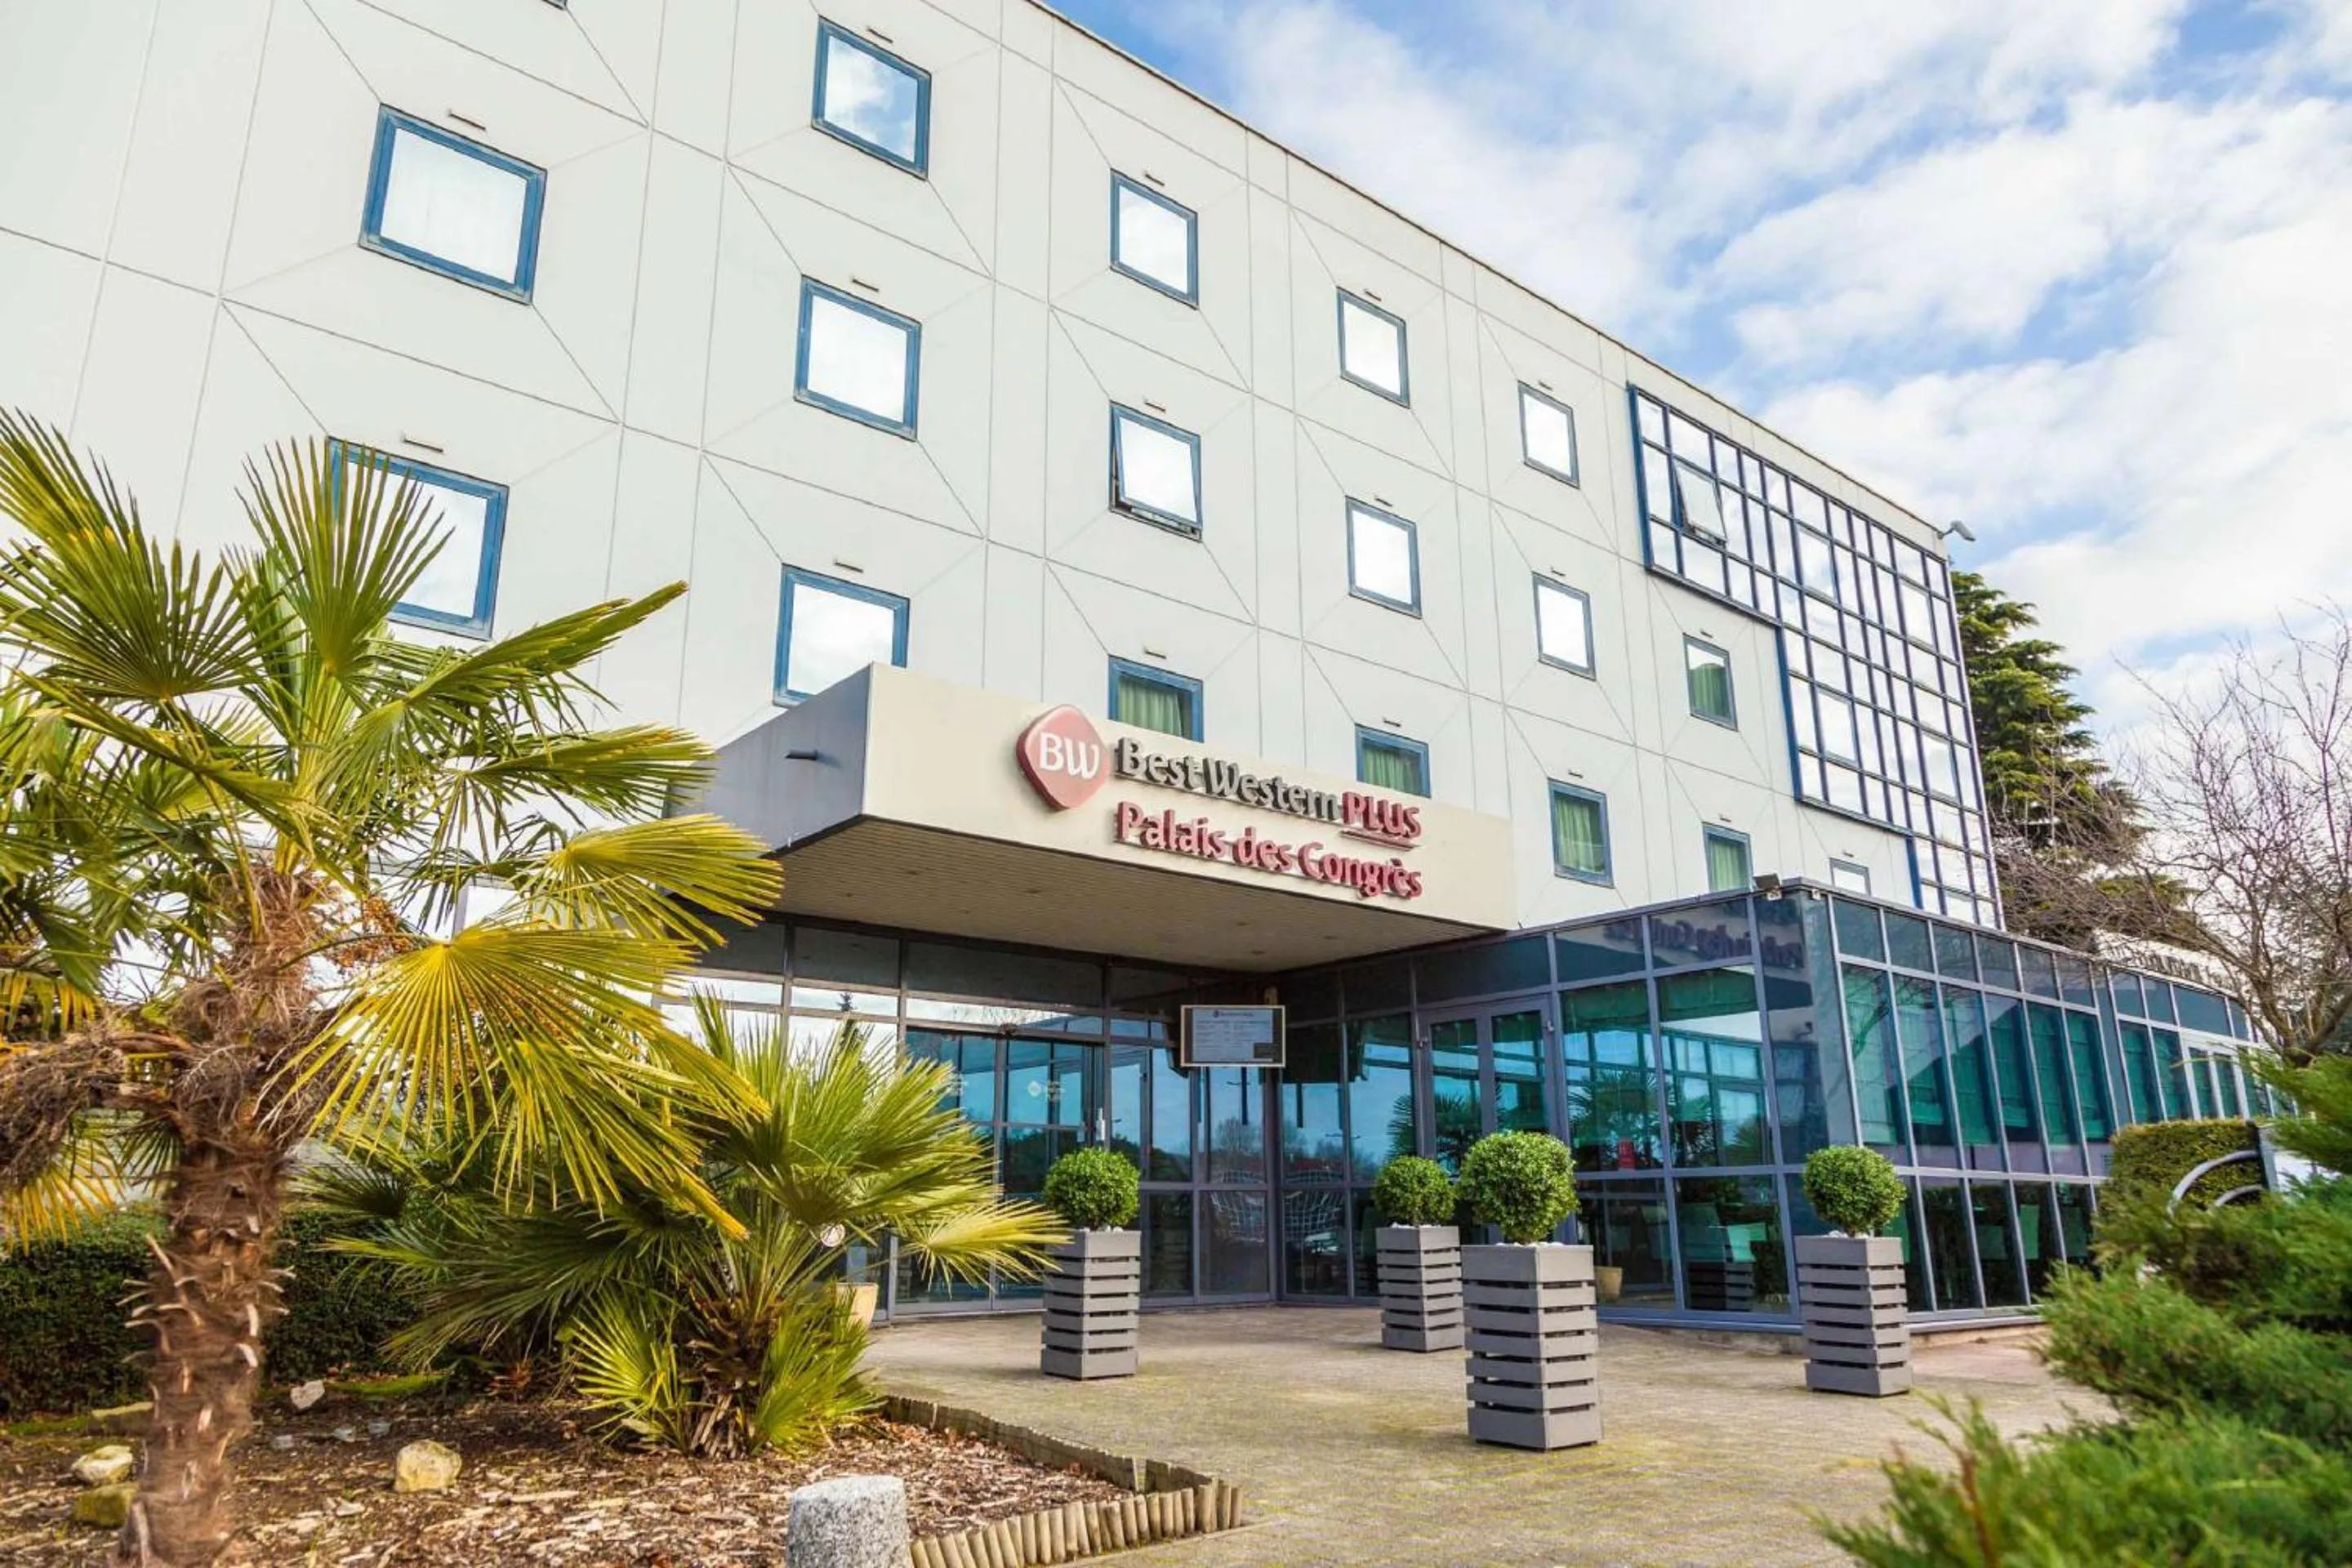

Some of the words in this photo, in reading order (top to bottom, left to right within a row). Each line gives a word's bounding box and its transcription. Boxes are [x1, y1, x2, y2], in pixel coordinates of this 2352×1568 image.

[1039, 732, 1100, 779] BW
[1116, 737, 1205, 790] Best
[1202, 757, 1340, 821] Western
[1342, 791, 1422, 839] PLUS
[1116, 800, 1226, 859] Palais
[1232, 826, 1293, 871] des
[1298, 841, 1423, 898] Congrès
